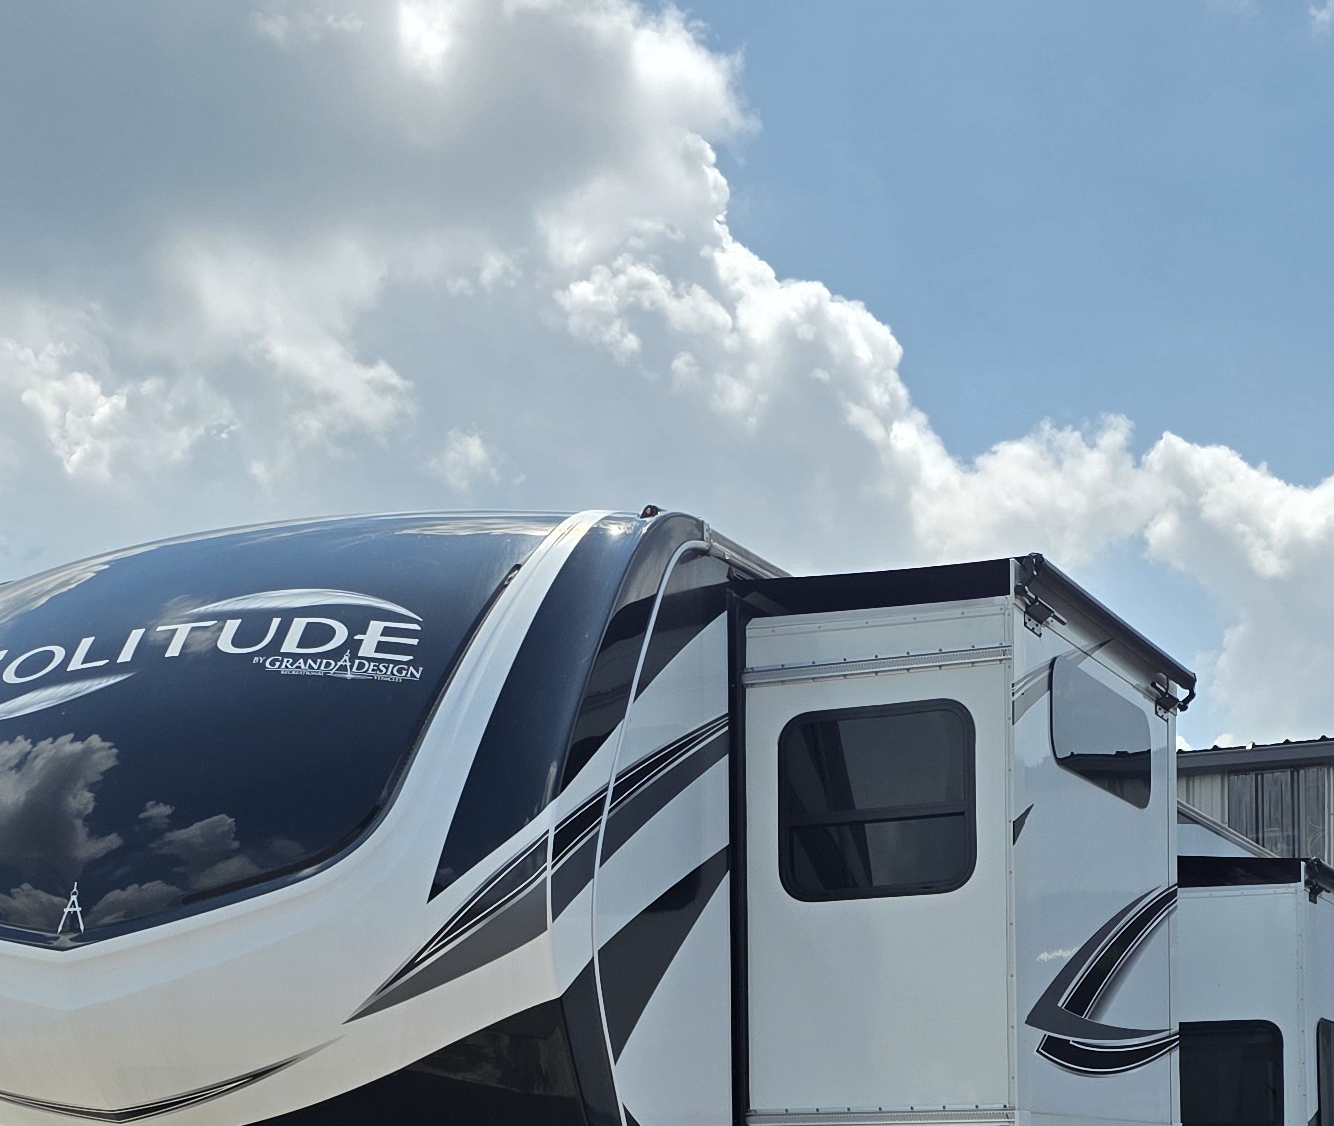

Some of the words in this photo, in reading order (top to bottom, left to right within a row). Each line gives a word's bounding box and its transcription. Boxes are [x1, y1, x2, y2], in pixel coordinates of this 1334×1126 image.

[252, 656, 267, 664] BY
[265, 656, 336, 671] GRAND
[351, 659, 424, 680] DESIGN
